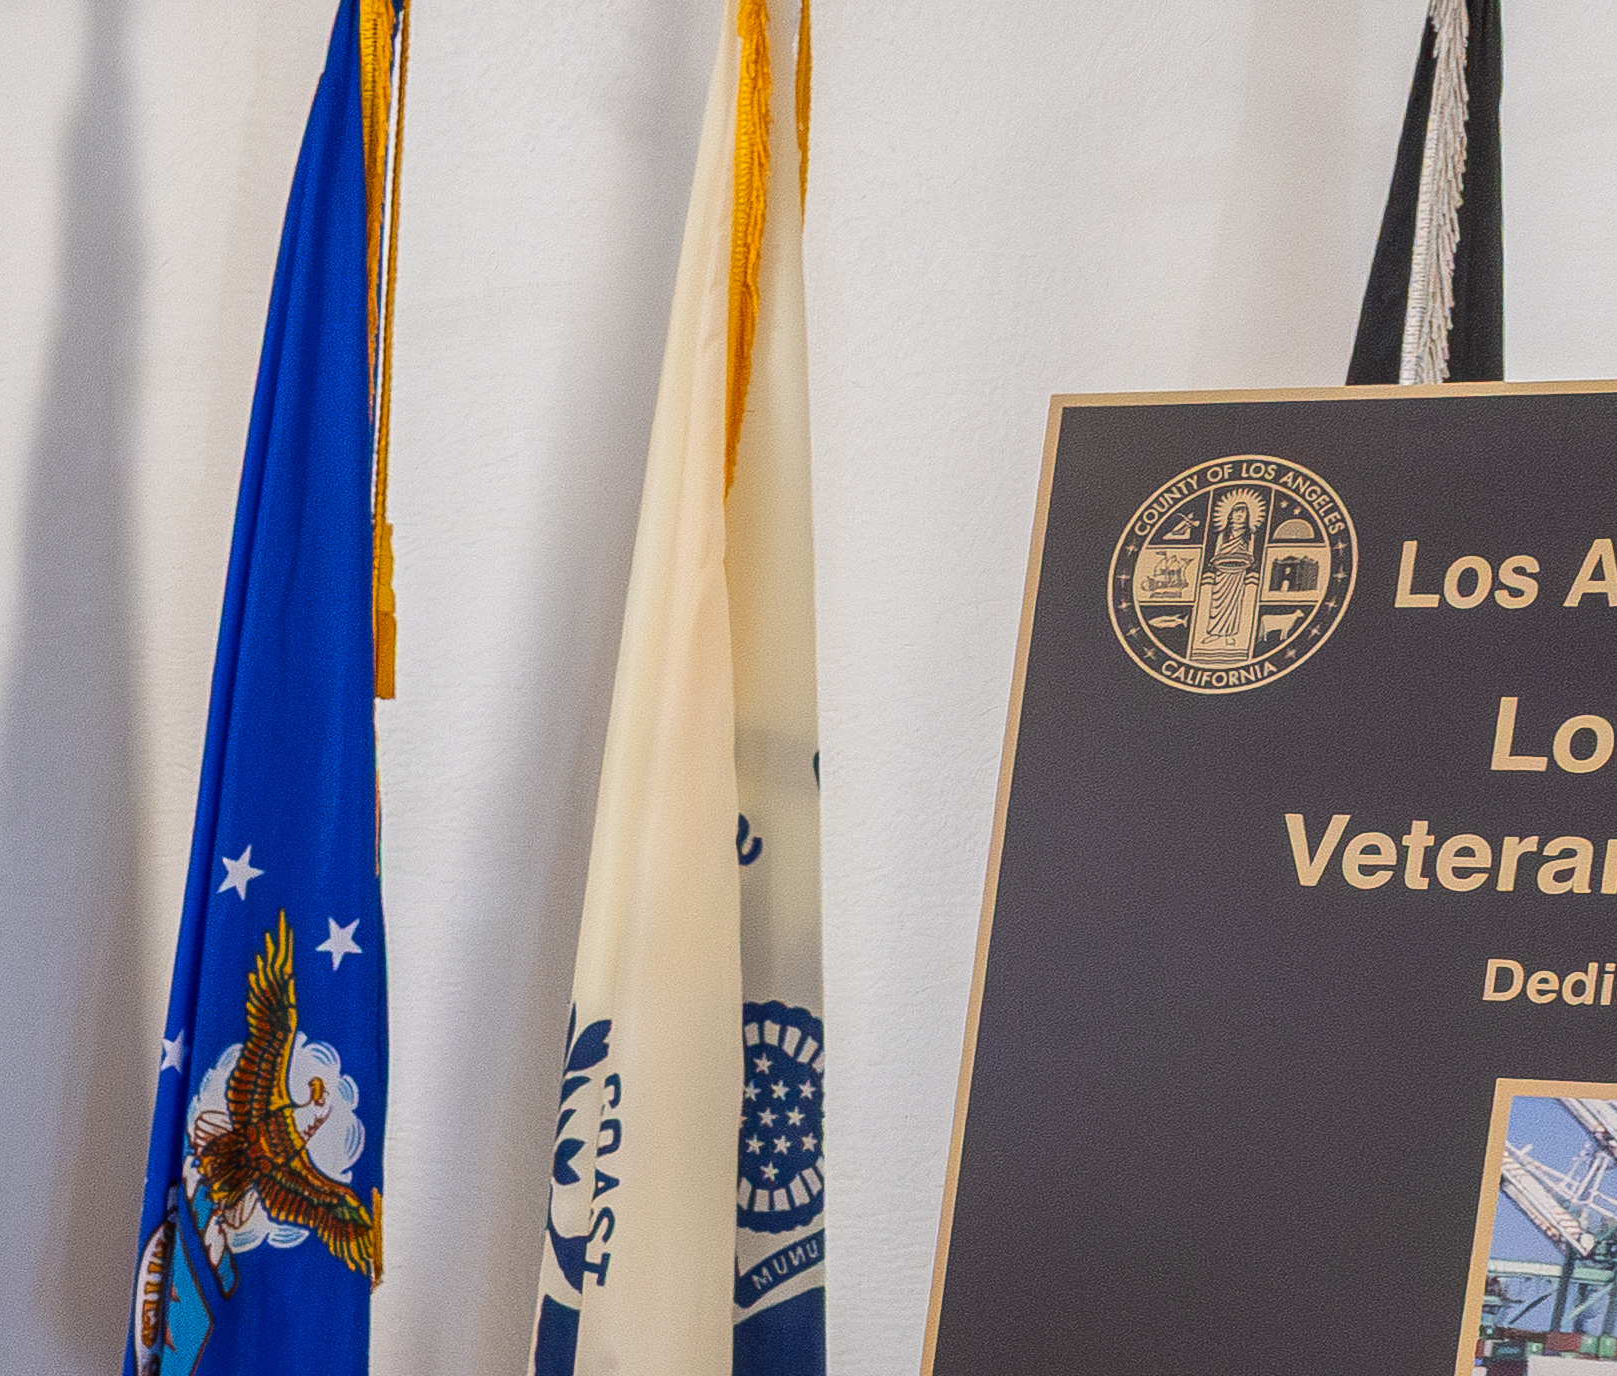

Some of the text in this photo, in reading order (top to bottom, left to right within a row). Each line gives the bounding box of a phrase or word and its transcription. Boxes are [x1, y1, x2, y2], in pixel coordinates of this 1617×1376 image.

[1134, 462, 1345, 536] COUNTY OF LOS ANGELES
[1393, 539, 1541, 610] Los
[1162, 660, 1278, 687] CALIFORNIA
